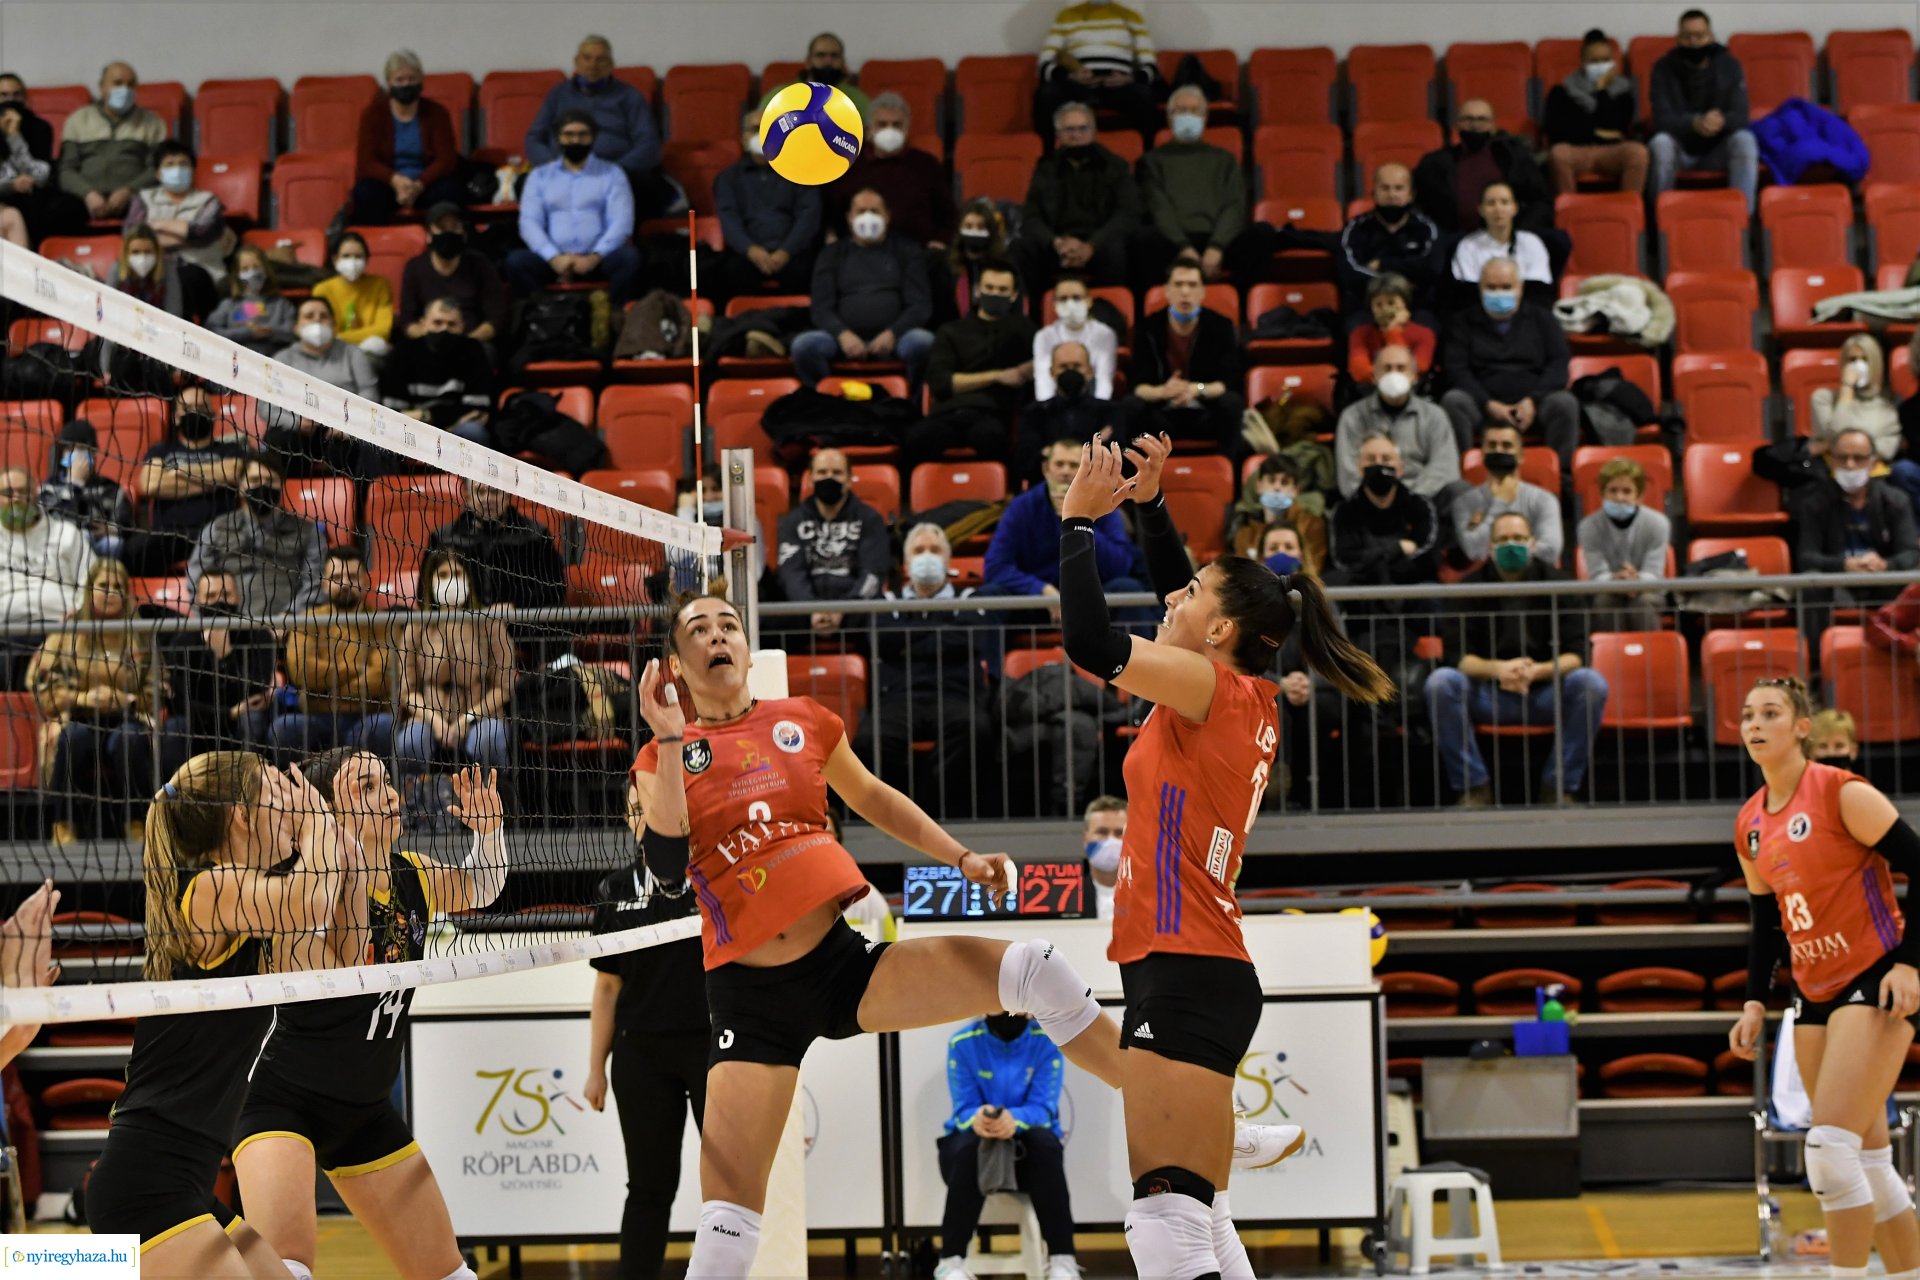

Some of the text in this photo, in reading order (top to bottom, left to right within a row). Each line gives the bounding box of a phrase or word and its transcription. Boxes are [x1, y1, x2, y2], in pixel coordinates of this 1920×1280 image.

[1024, 864, 1082, 877] FATUM
[908, 880, 962, 915] 27
[1023, 878, 1078, 913] 27
[1784, 893, 1814, 932] 13
[475, 1067, 550, 1135] 75
[462, 1151, 600, 1176] RÖPLABDA
